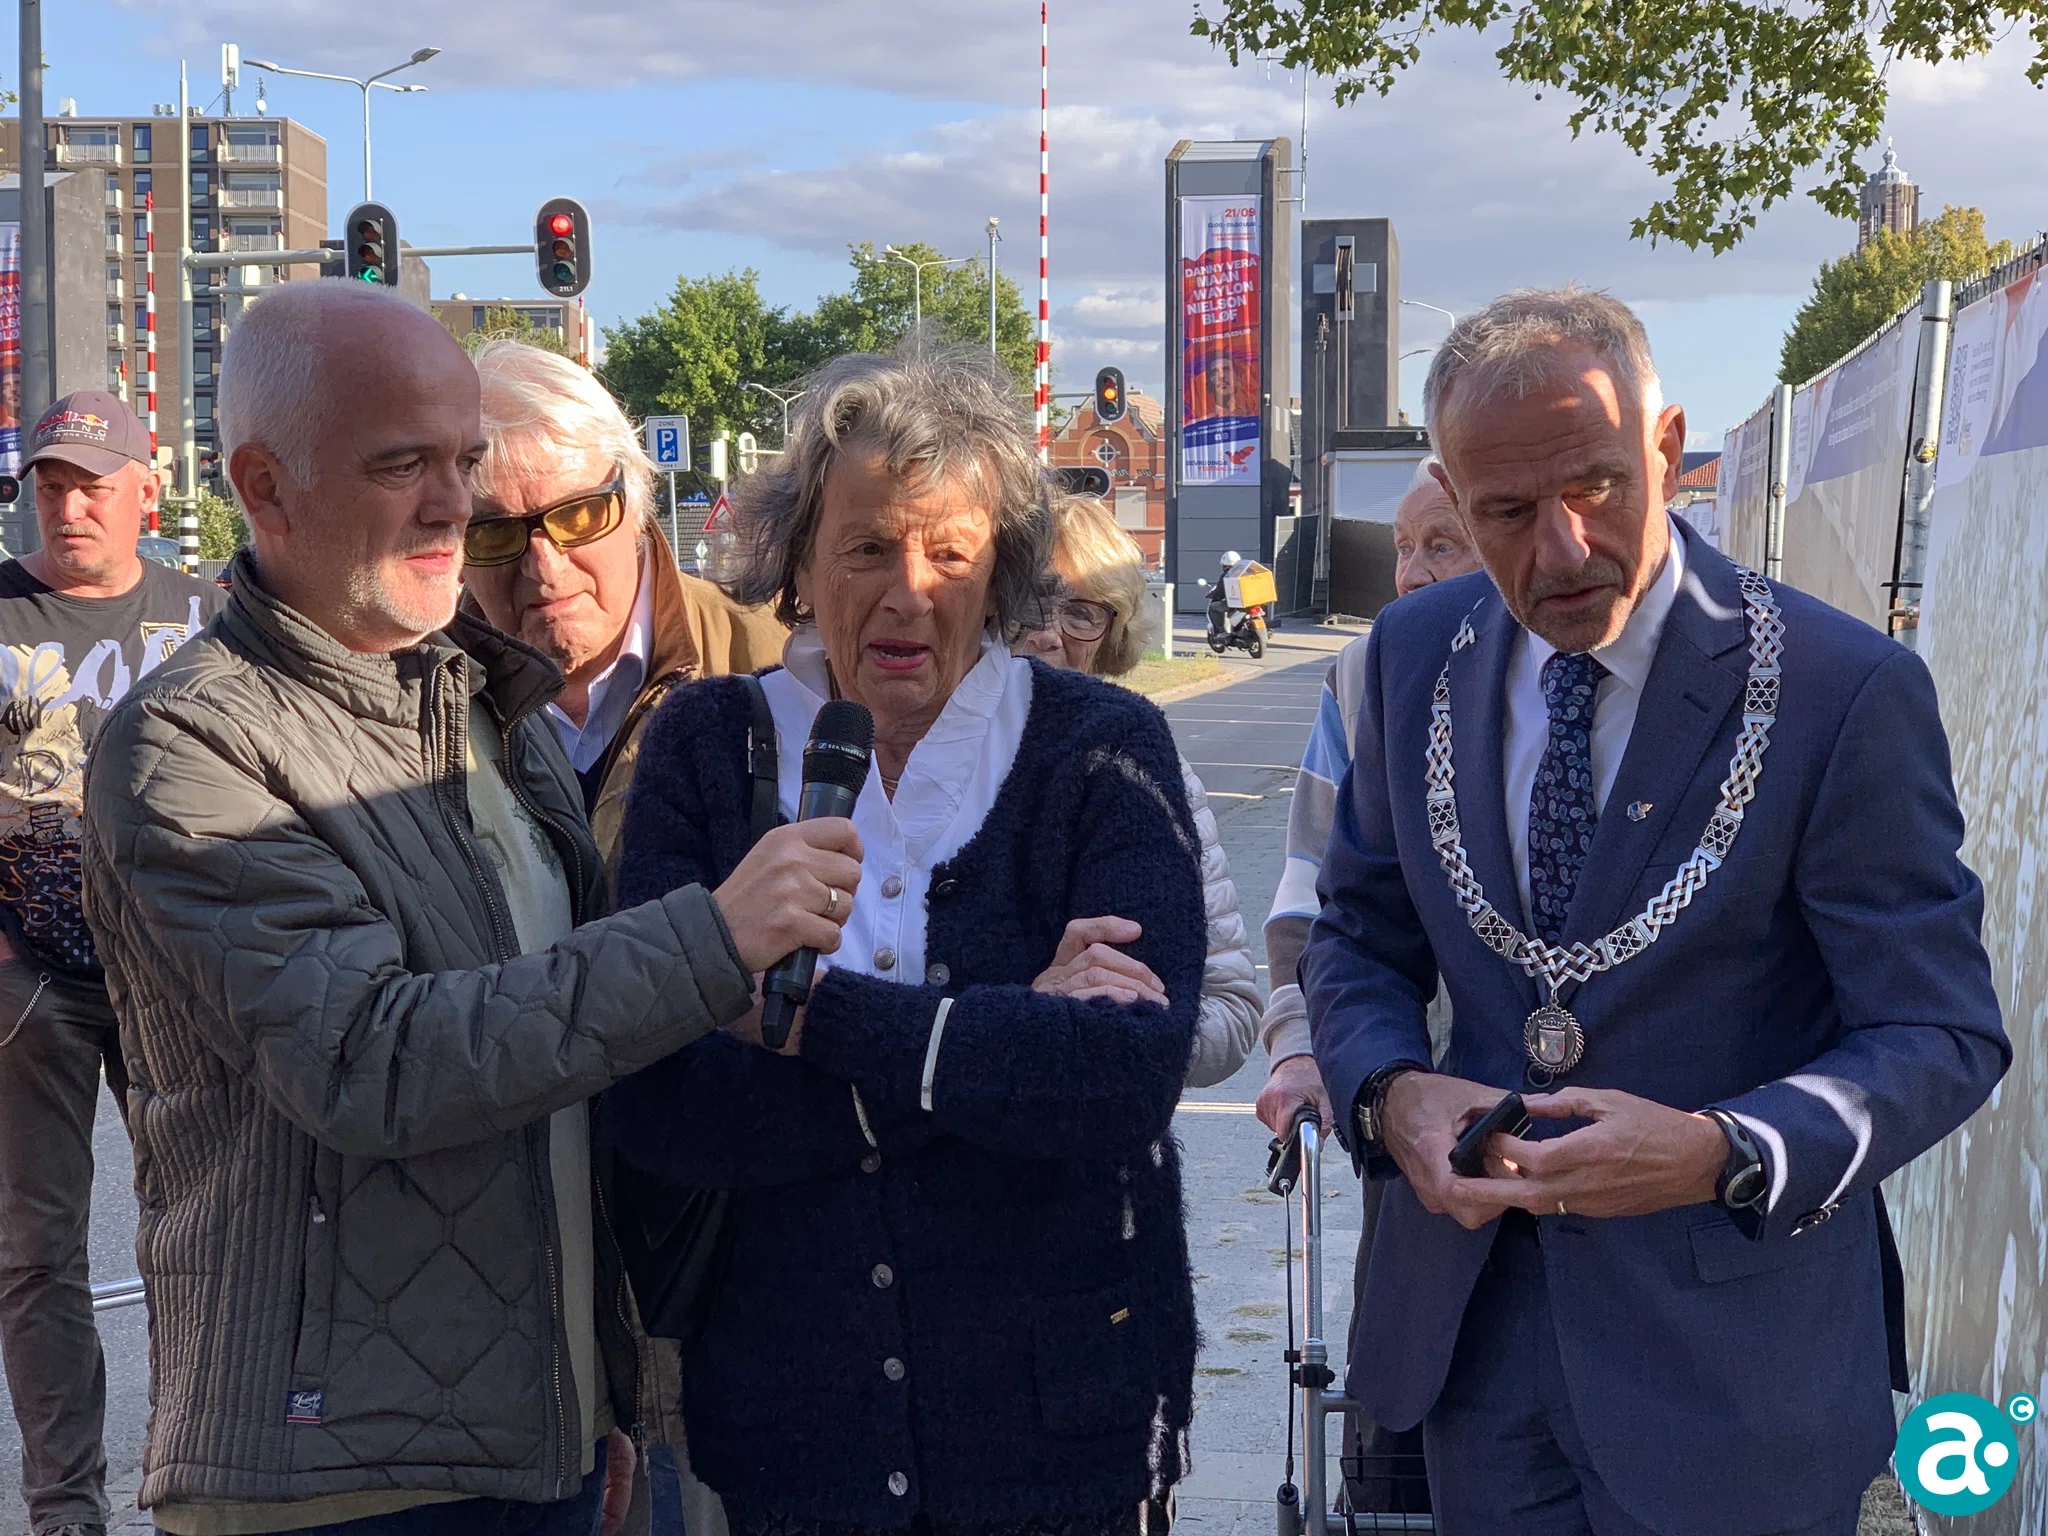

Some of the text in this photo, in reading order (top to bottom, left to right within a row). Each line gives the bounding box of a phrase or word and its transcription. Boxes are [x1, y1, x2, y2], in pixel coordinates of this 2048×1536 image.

[1225, 208, 1256, 217] 21/09
[1185, 257, 1257, 278] DANNY VERA
[1197, 270, 1240, 287] MAAN
[1193, 281, 1254, 300] WAYLON
[1187, 295, 1247, 315] NIELSON
[1202, 309, 1238, 325] BLØF
[661, 430, 674, 448] P
